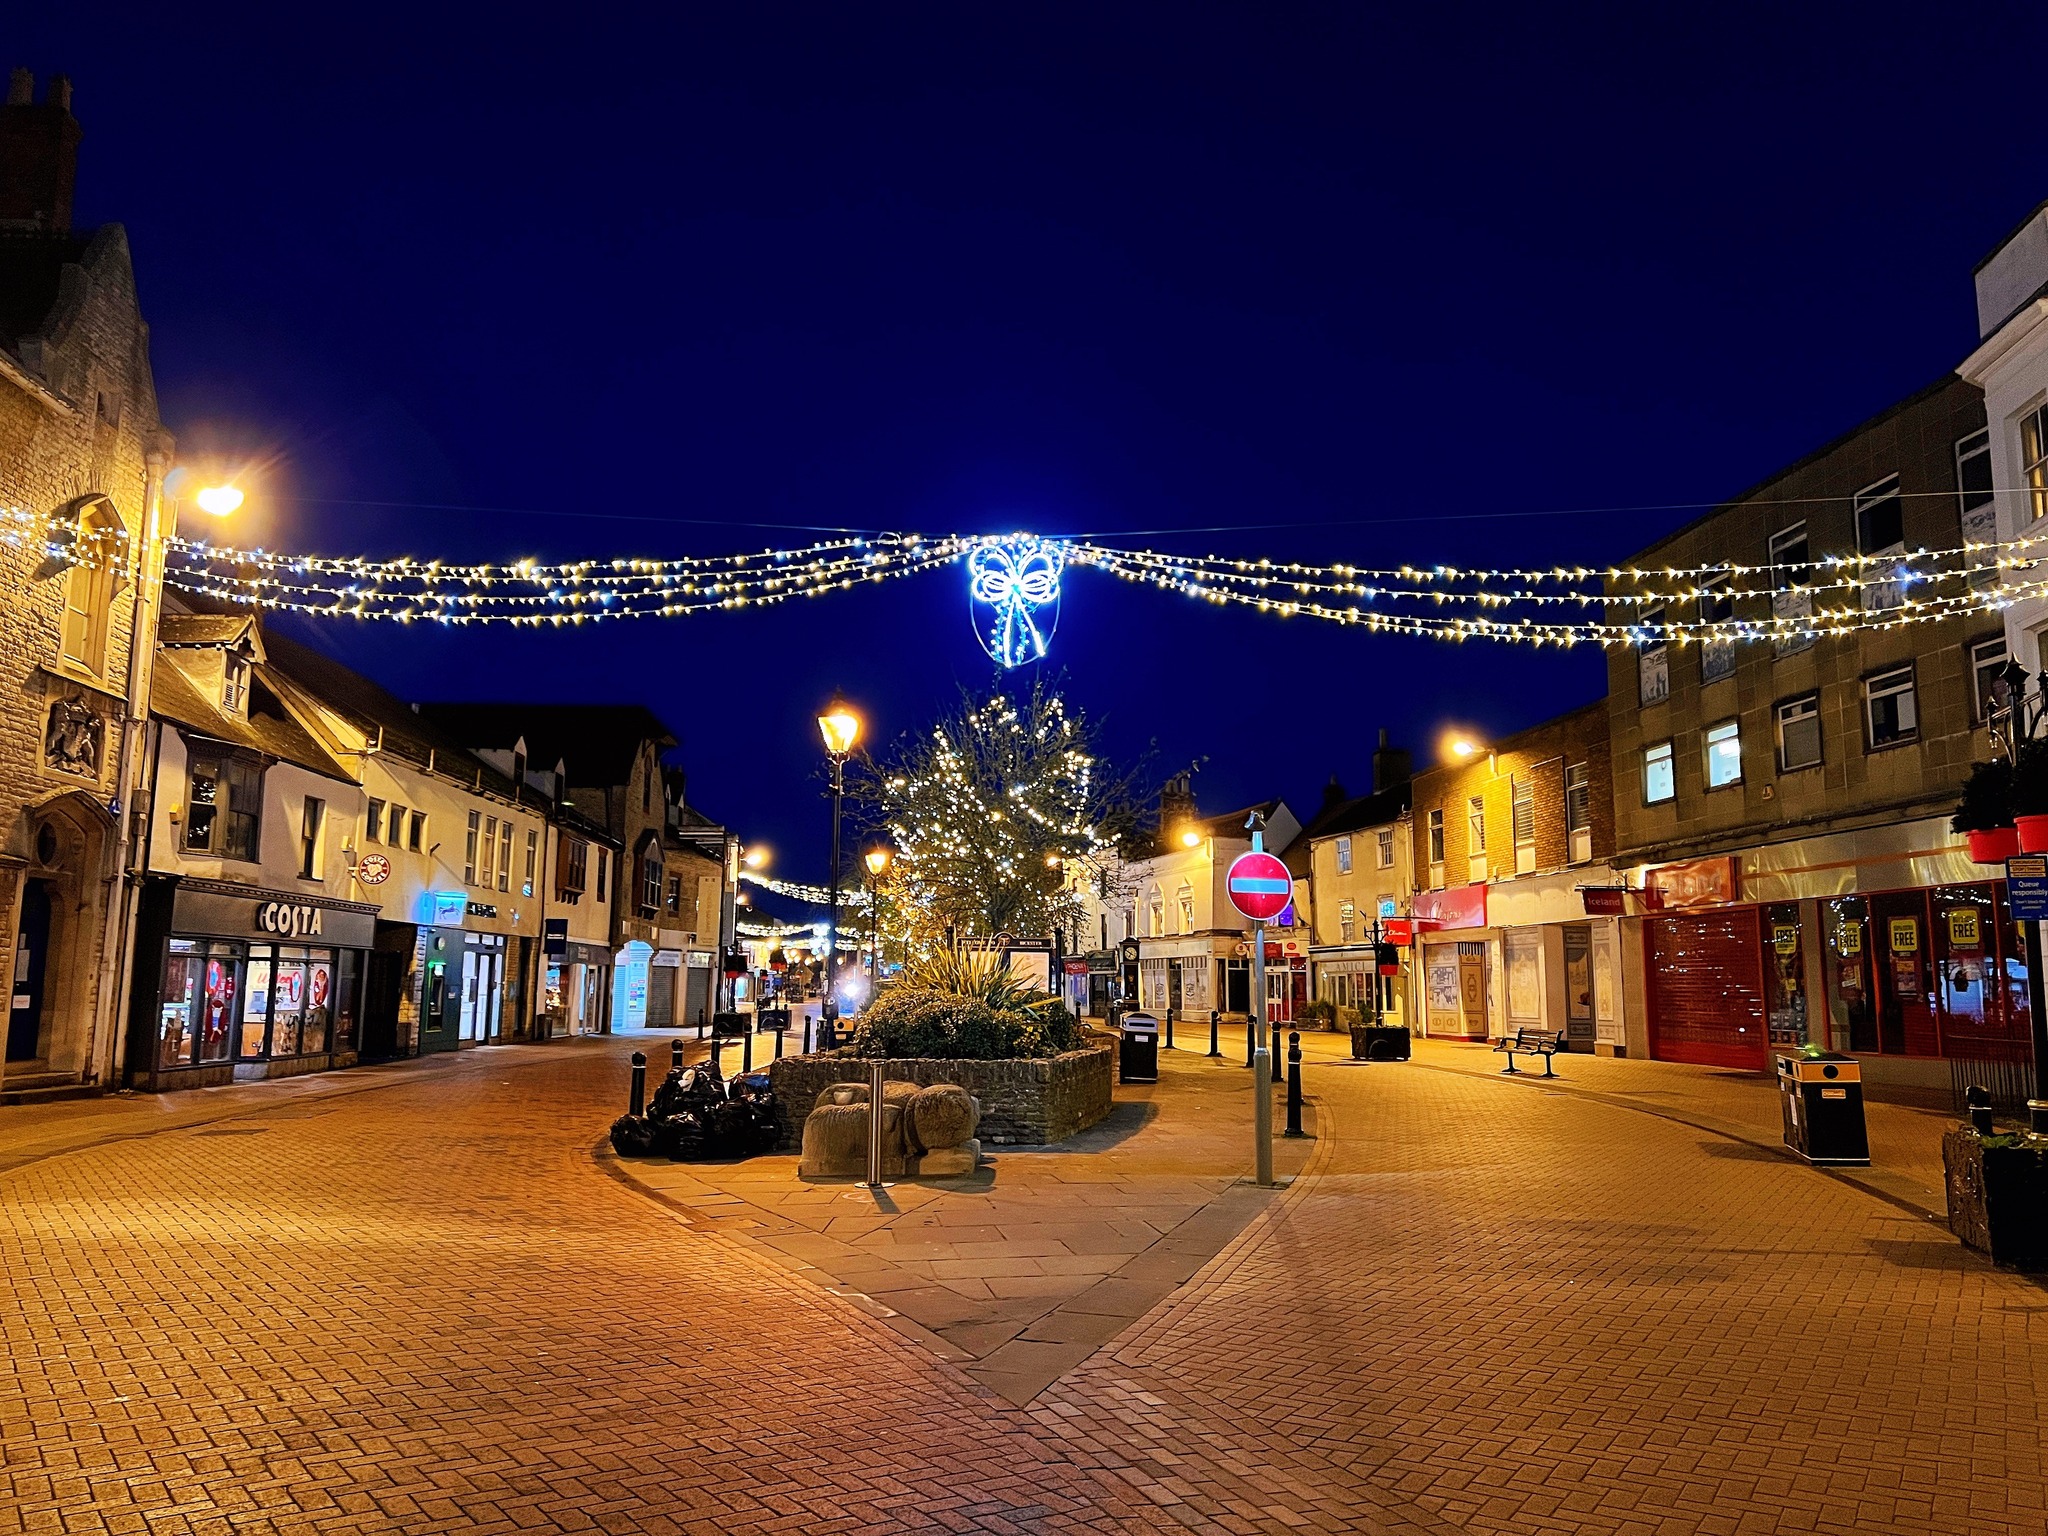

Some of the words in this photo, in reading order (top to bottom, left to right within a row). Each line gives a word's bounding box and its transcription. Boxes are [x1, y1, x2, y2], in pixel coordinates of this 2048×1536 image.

[363, 856, 386, 866] COSTA
[2011, 889, 2048, 897] responsibly
[1587, 897, 1621, 906] Iceland
[265, 901, 322, 938] COSTA
[1775, 929, 1795, 943] FREE
[1953, 923, 1976, 938] FREE
[1894, 931, 1915, 946] FREE
